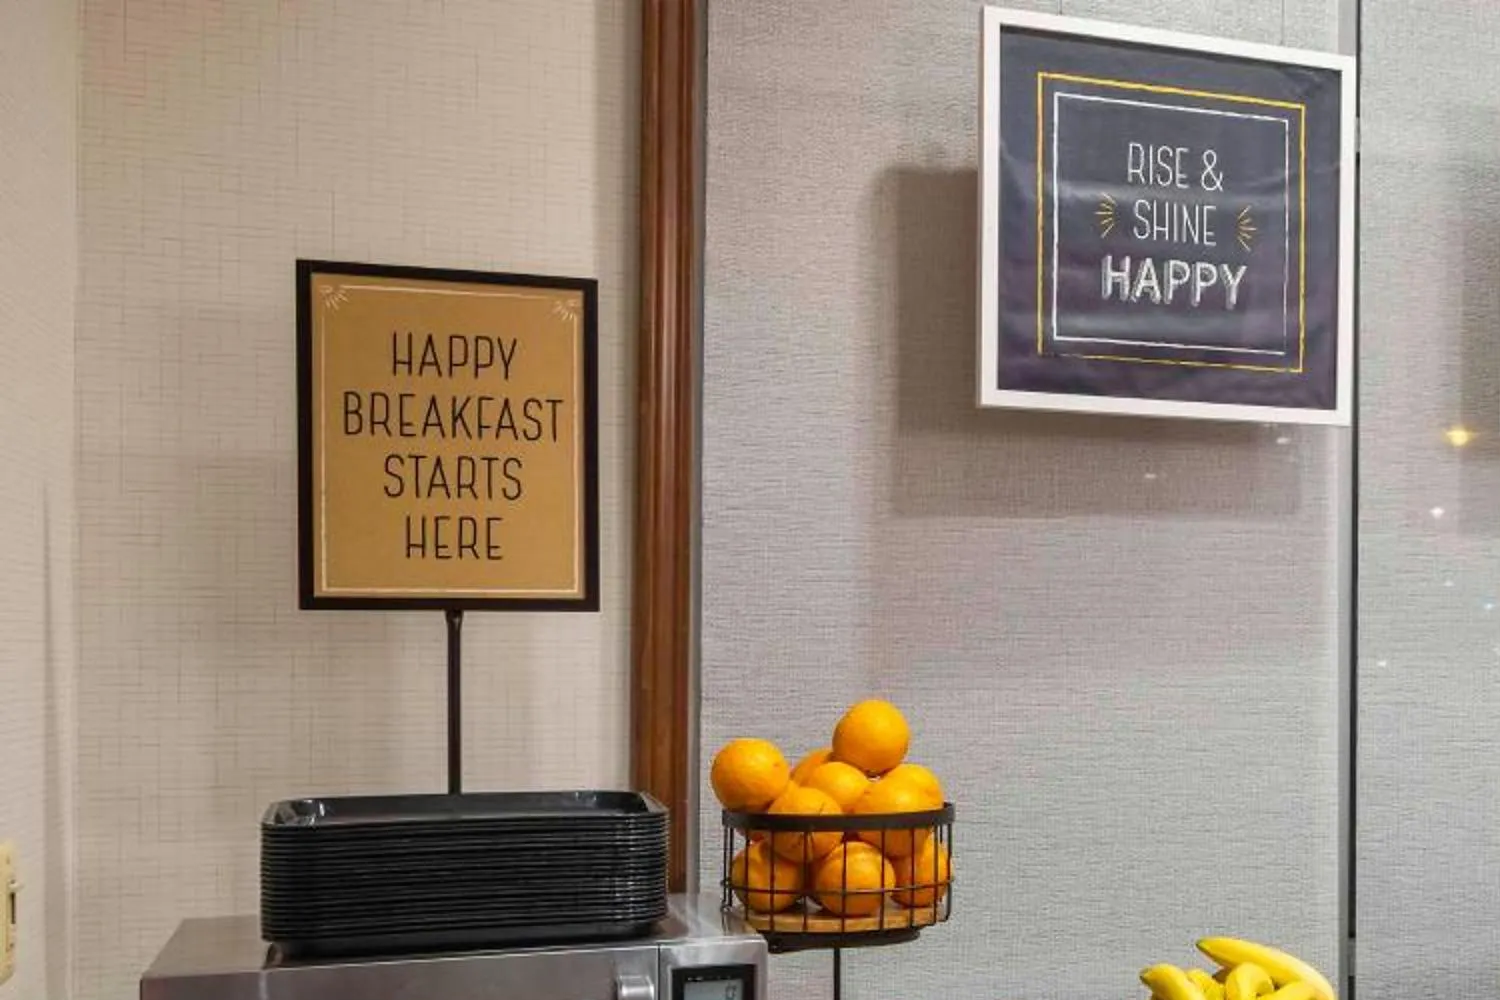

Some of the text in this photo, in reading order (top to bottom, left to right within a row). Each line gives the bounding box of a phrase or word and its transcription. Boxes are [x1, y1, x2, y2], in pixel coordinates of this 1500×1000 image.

[1126, 141, 1224, 192] RISE &
[1132, 199, 1217, 247] SHINE
[1101, 254, 1248, 309] HAPPY
[392, 331, 518, 380] HAPPY
[343, 391, 564, 442] BREAKFAST
[383, 454, 524, 501] STARTS
[405, 515, 504, 561] HERE
